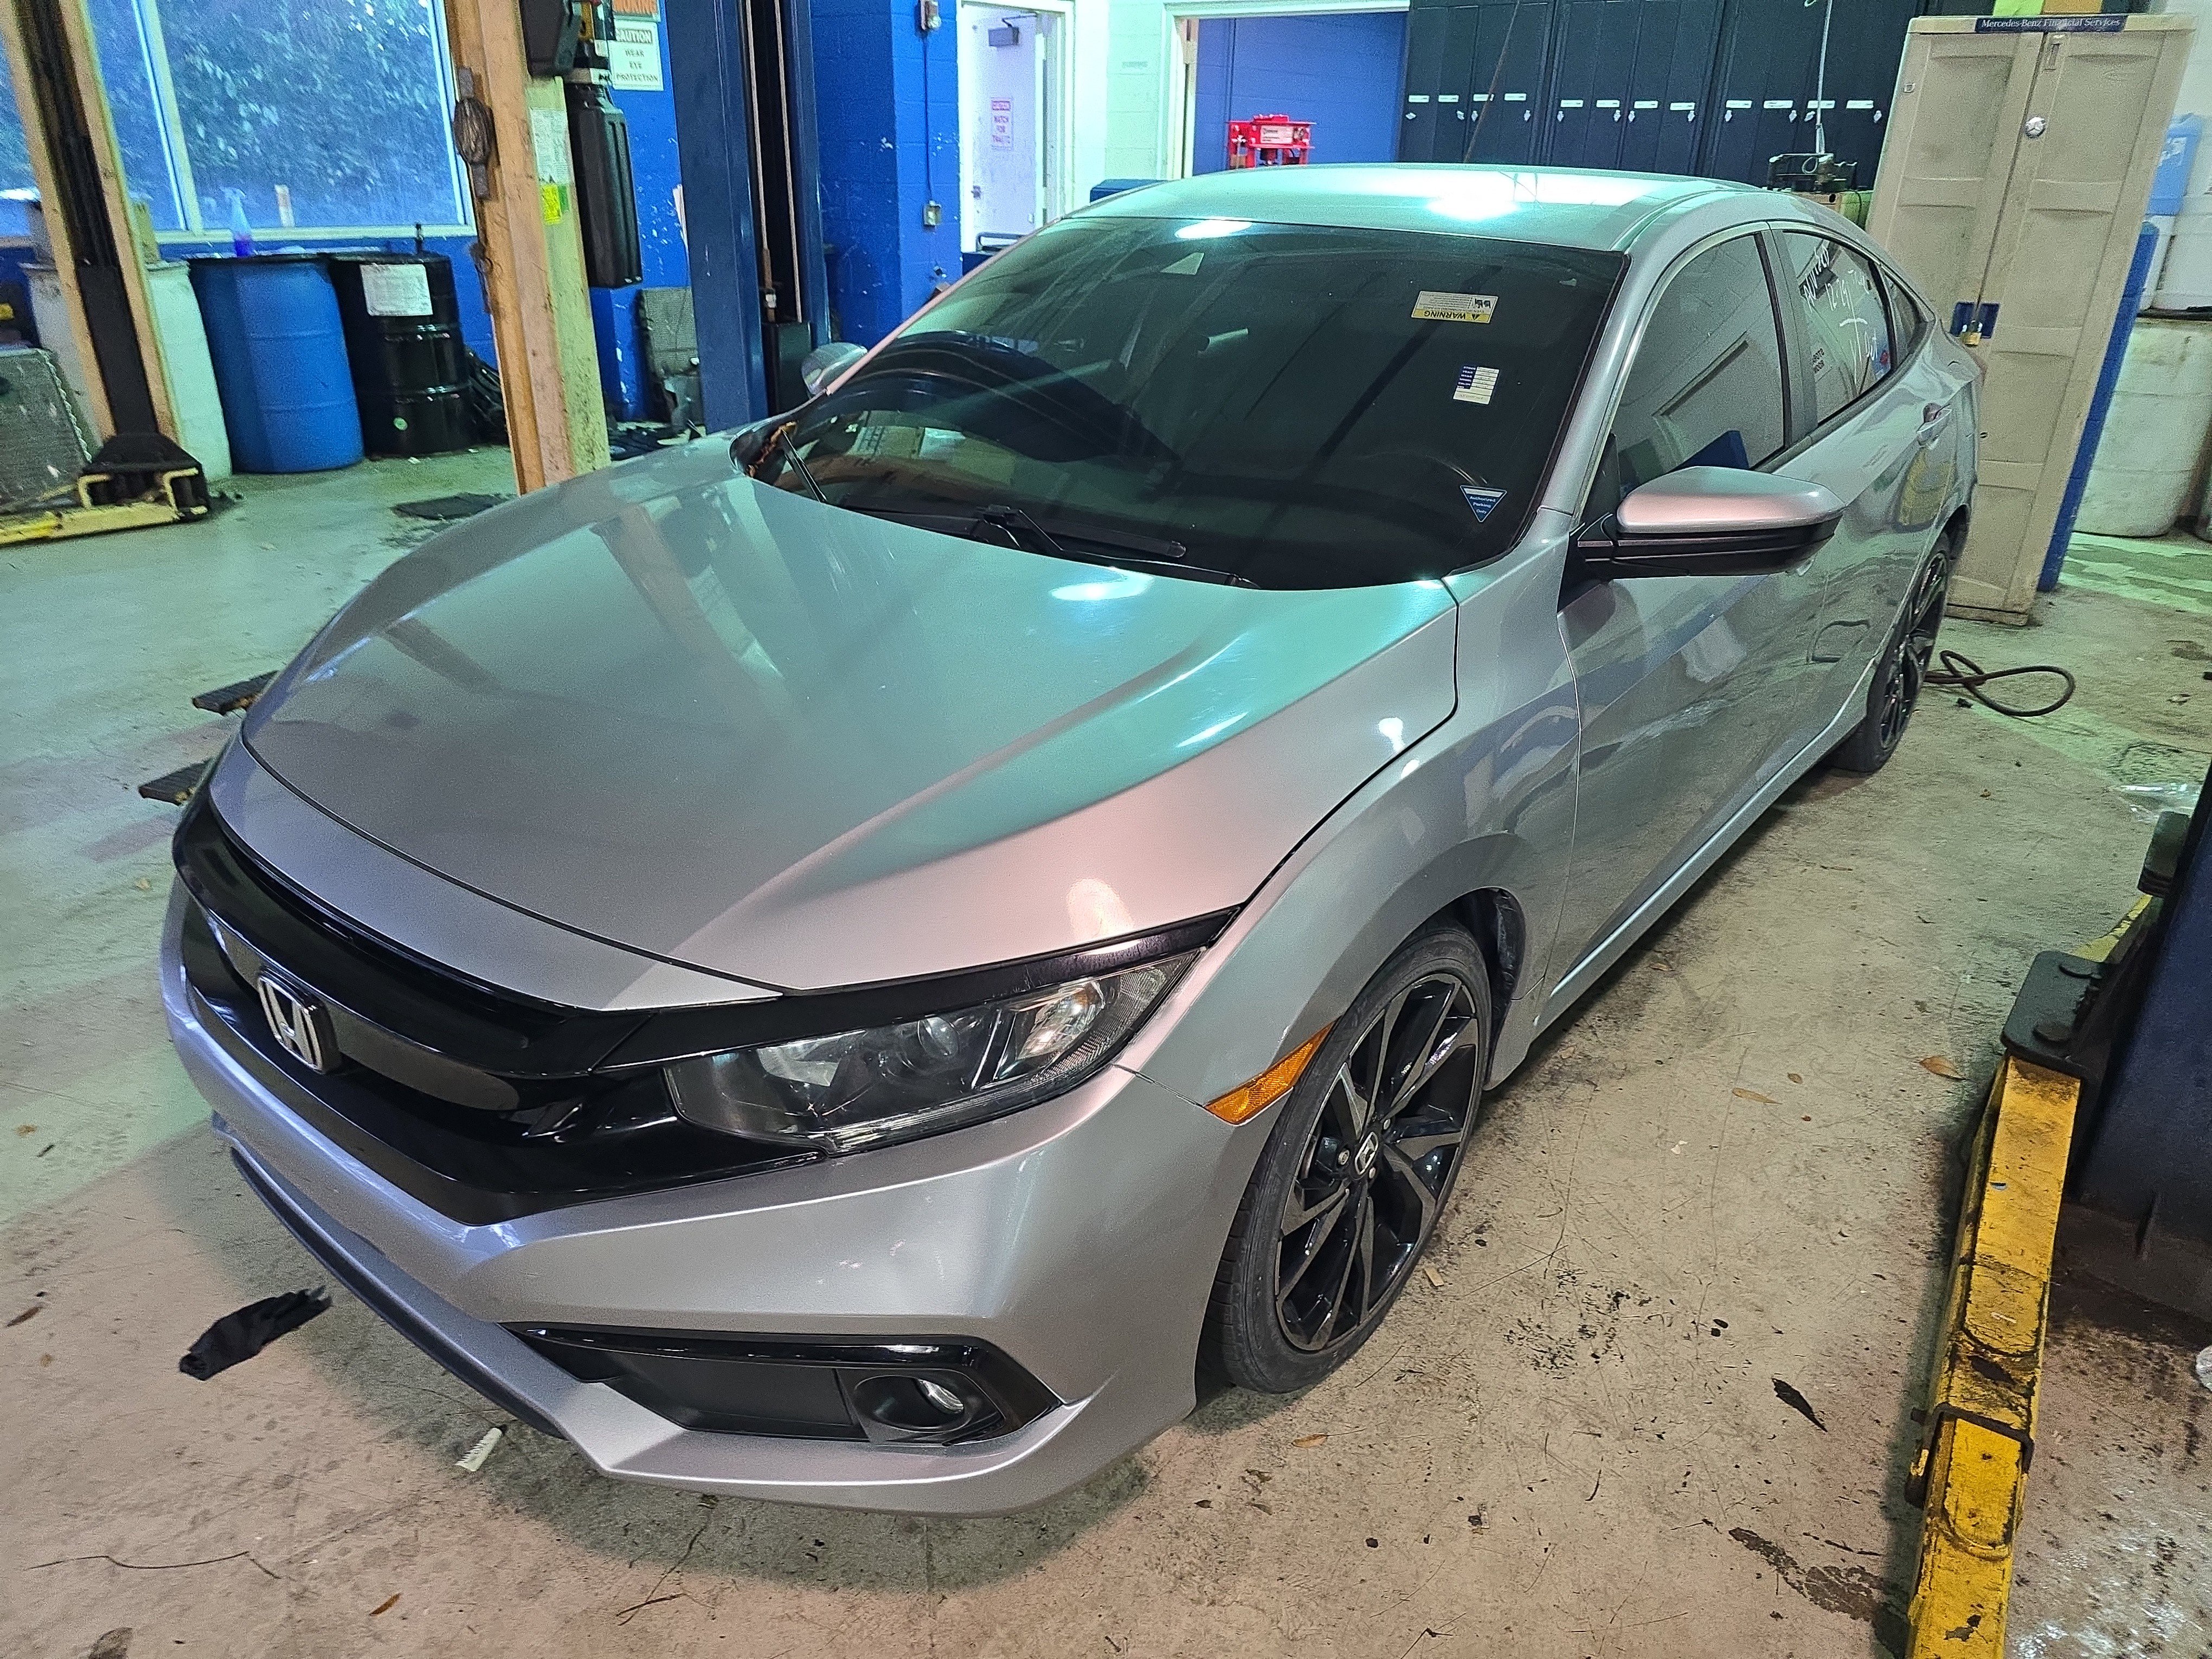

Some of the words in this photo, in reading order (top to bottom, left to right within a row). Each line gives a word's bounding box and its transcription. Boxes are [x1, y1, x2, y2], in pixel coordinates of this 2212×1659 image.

[1982, 19, 2041, 28] Mercedes-Benz
[2084, 18, 2120, 27] Services
[616, 29, 651, 43] CAUTION
[625, 49, 645, 57] WEAR
[629, 61, 642, 69] EYE
[616, 73, 658, 81] PROTECTION
[1424, 311, 1466, 319] WARNING
